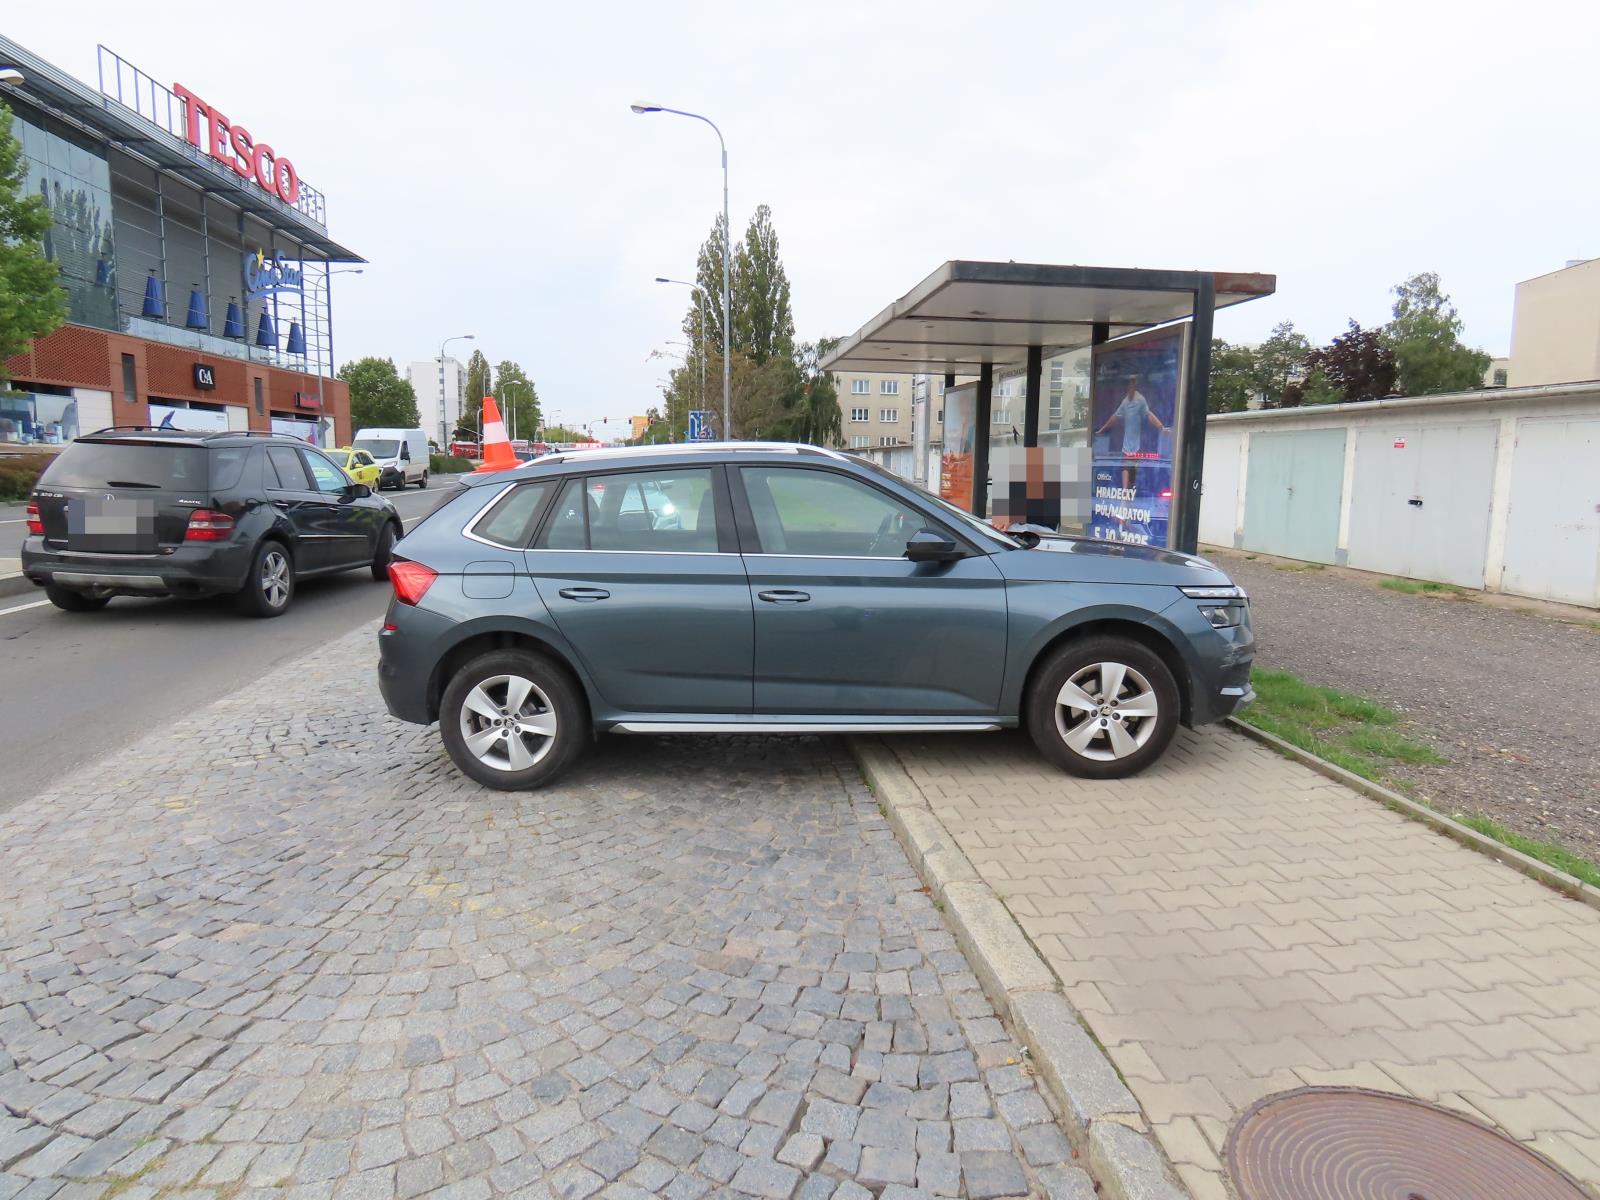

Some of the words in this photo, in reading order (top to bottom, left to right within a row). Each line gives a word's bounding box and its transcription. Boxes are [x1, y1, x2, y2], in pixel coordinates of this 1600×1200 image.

[173, 82, 299, 205] TESCO
[198, 368, 214, 385] C&A
[1096, 485, 1137, 501] HRADECKÝ
